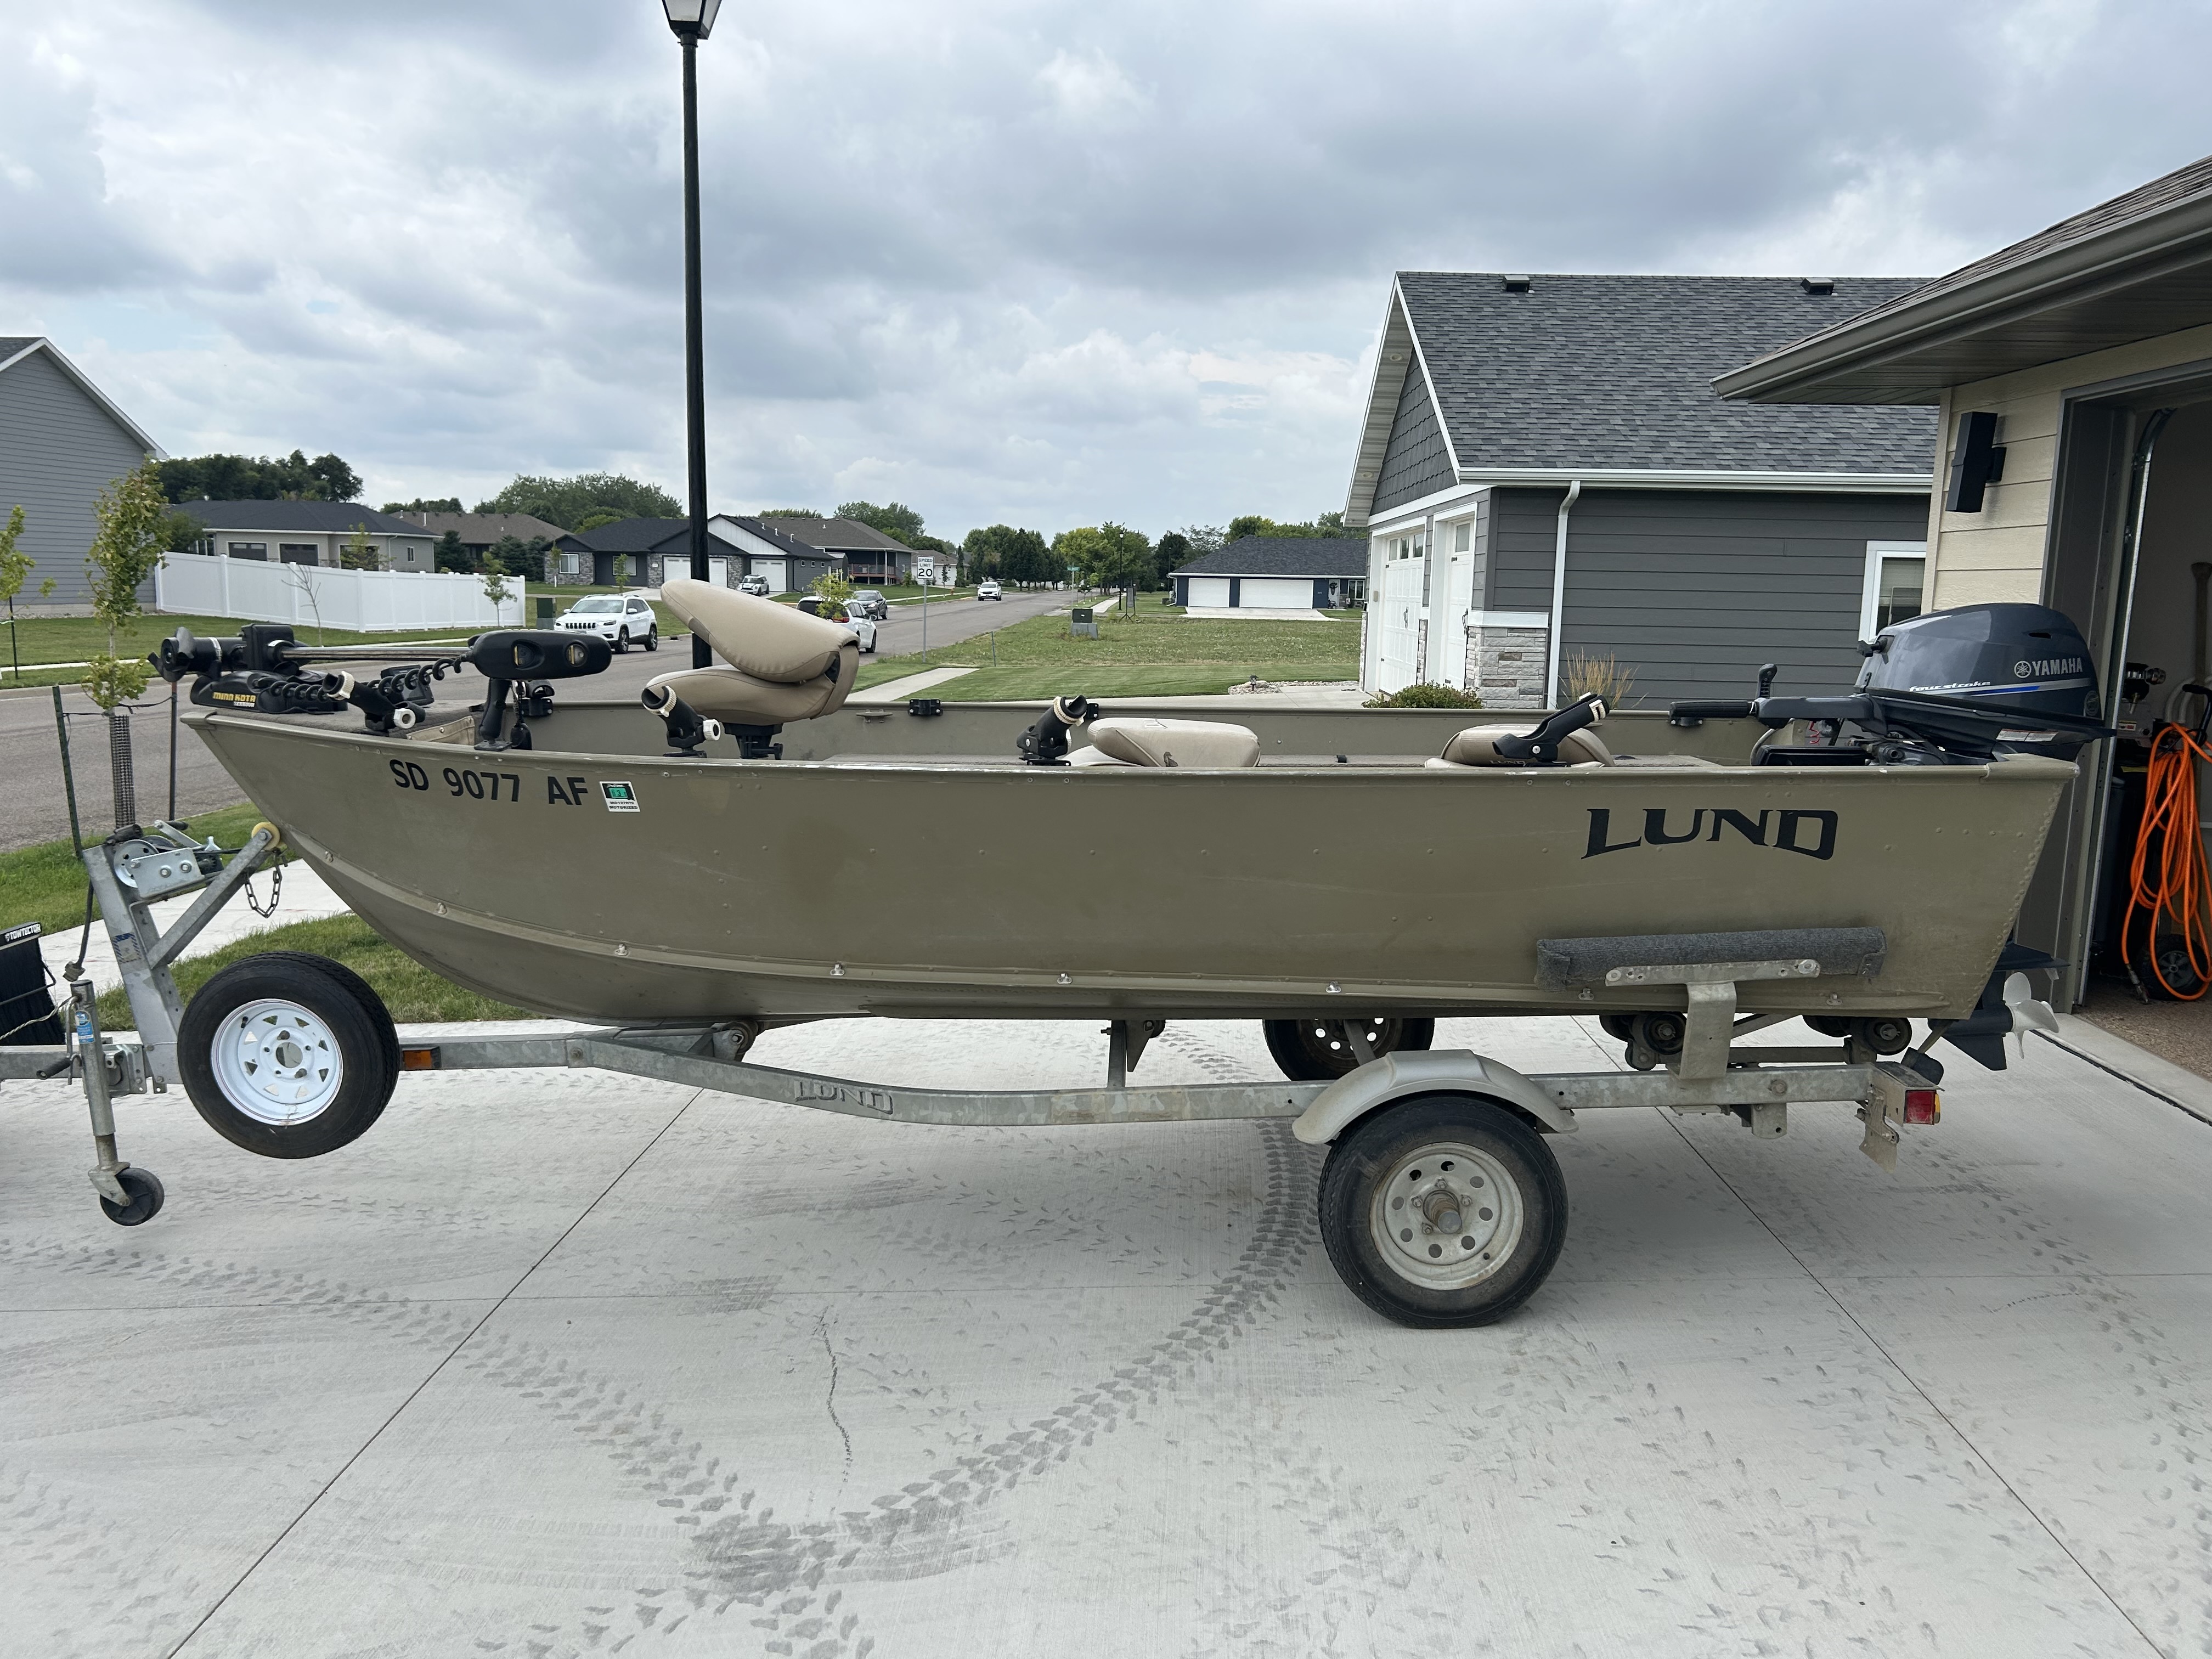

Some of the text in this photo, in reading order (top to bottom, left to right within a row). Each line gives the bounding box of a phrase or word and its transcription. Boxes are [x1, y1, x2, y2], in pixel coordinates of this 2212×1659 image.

[918, 568, 933, 577] 20
[2032, 657, 2083, 676] YAMAHA
[234, 693, 256, 702] KOTA
[390, 759, 588, 805] SD 9077 AF
[1581, 809, 1838, 860] LUND
[794, 1078, 894, 1115] LUND
